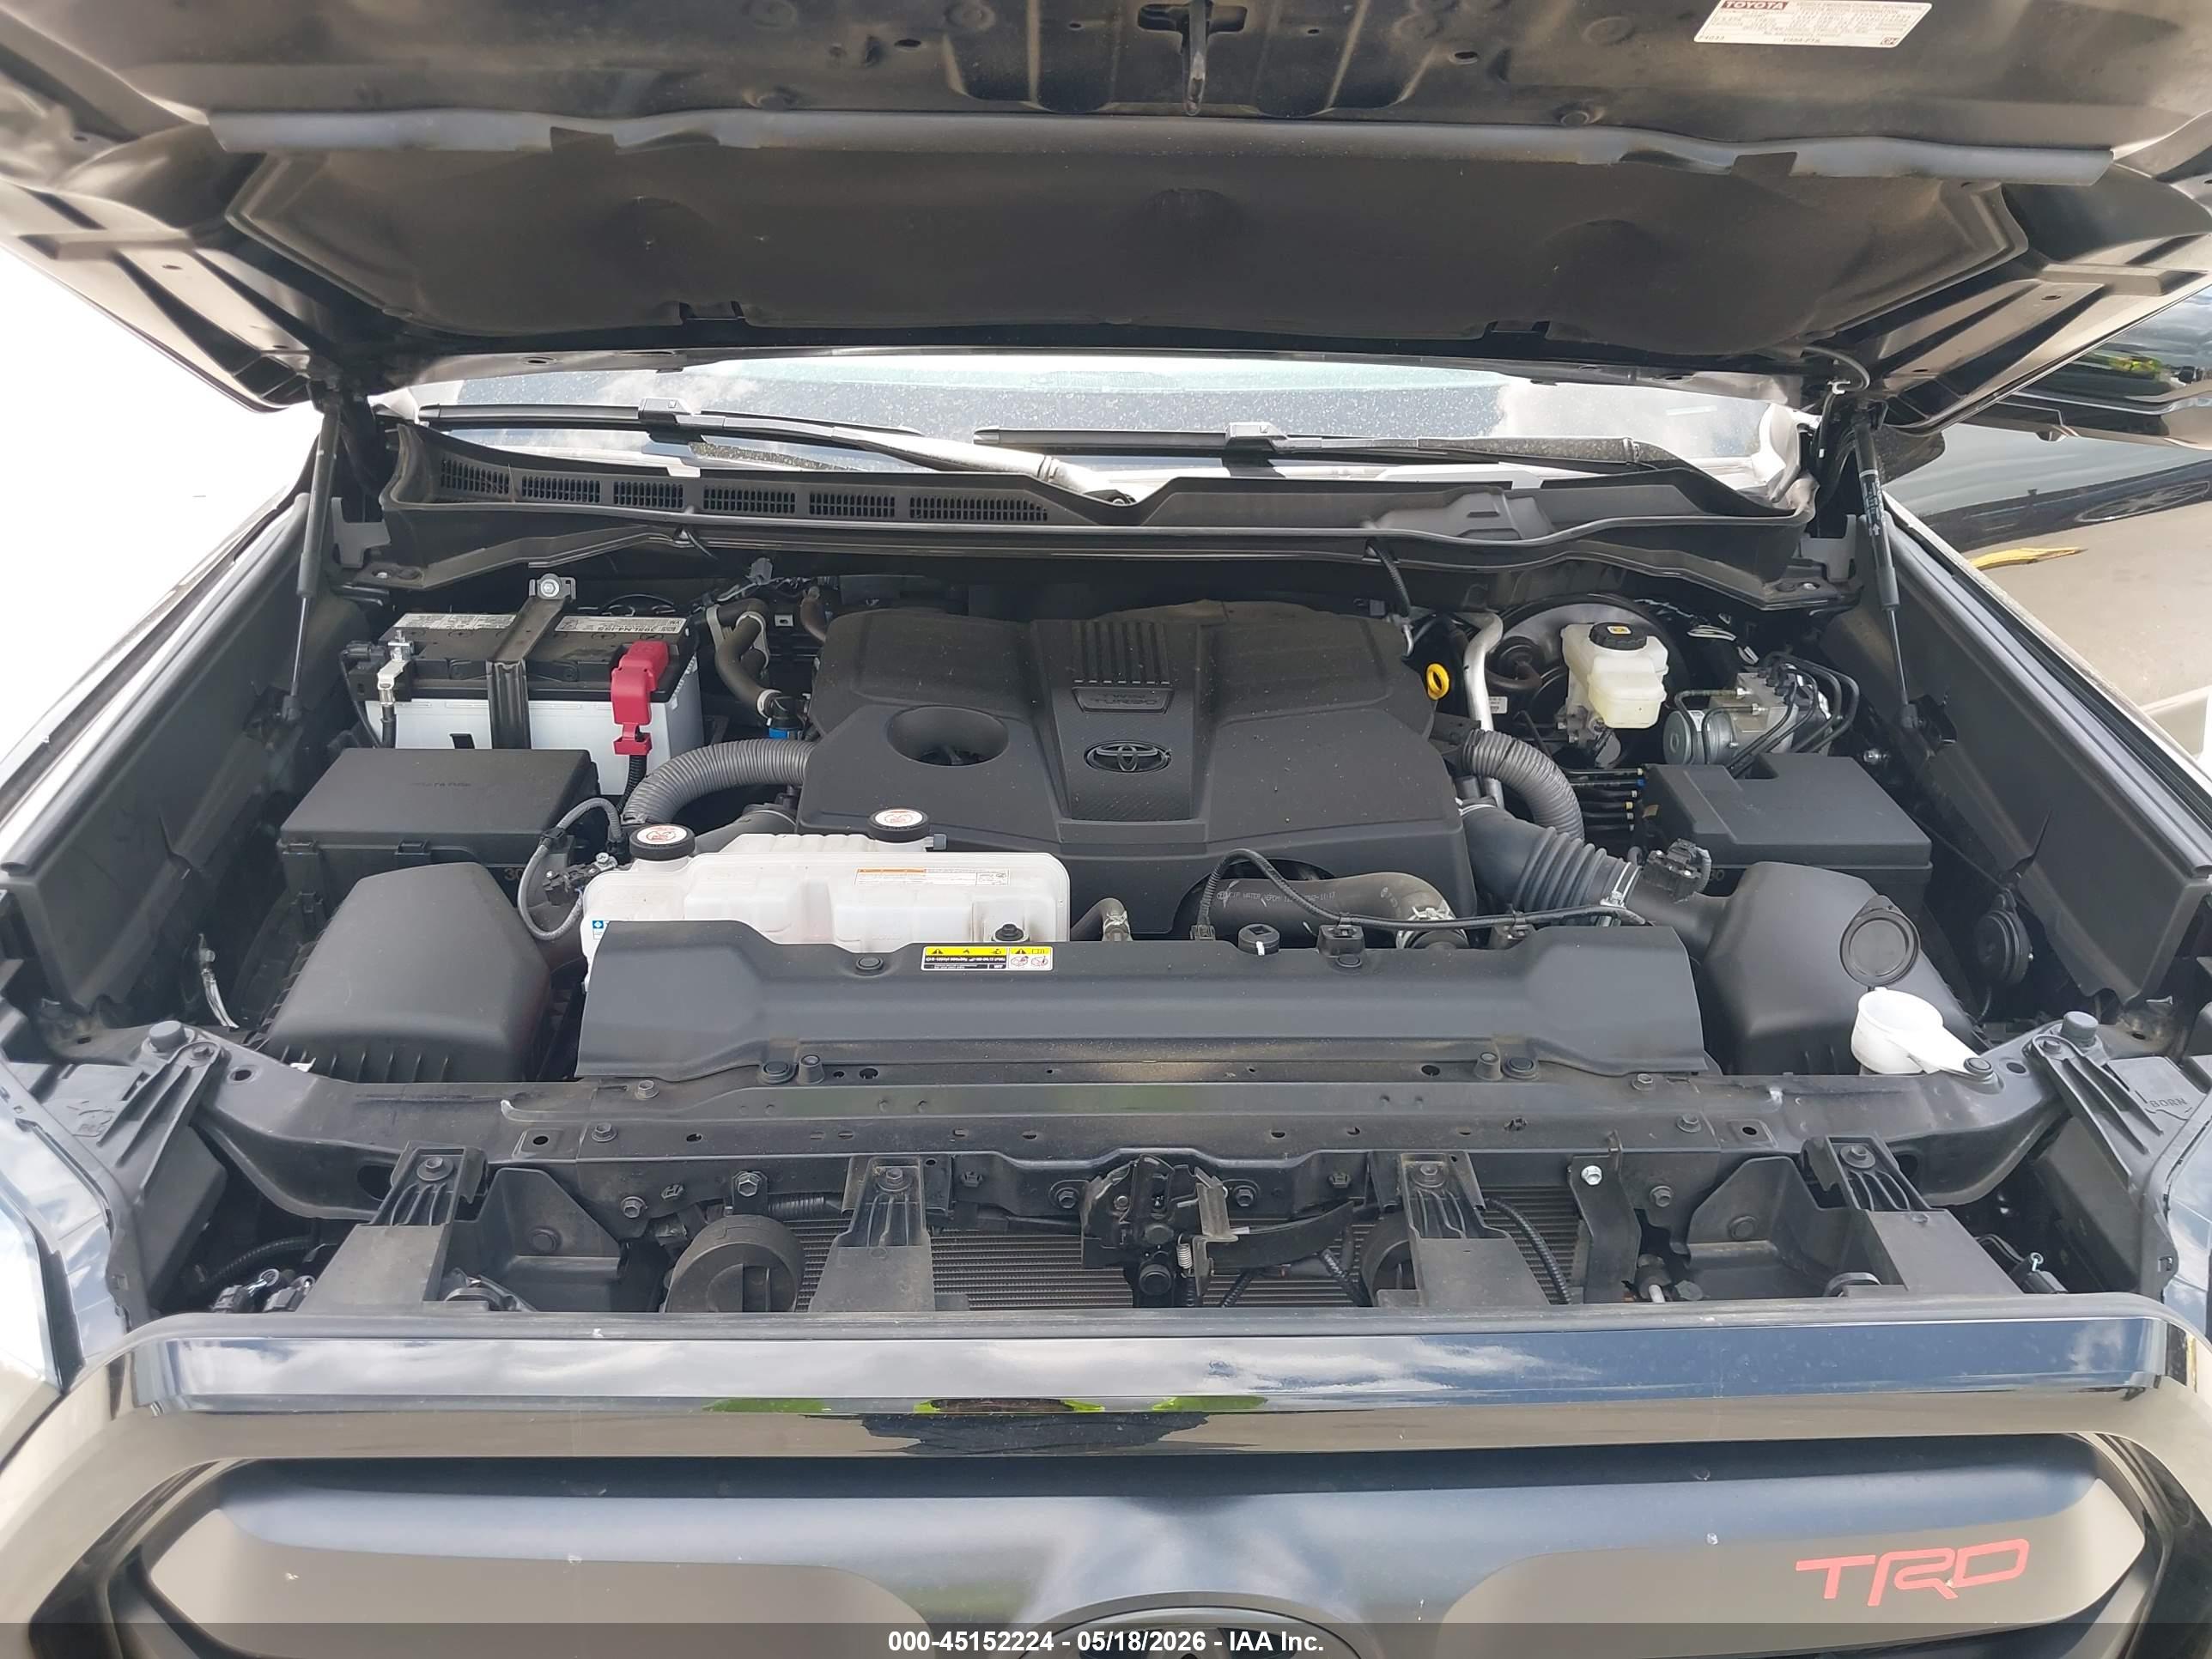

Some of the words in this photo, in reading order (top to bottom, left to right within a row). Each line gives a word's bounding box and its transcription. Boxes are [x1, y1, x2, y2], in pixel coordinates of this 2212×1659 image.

[1726, 1, 1784, 9] TOYOTA
[2149, 1097, 2189, 1108] BORN
[1795, 1538, 2030, 1607] TRD
